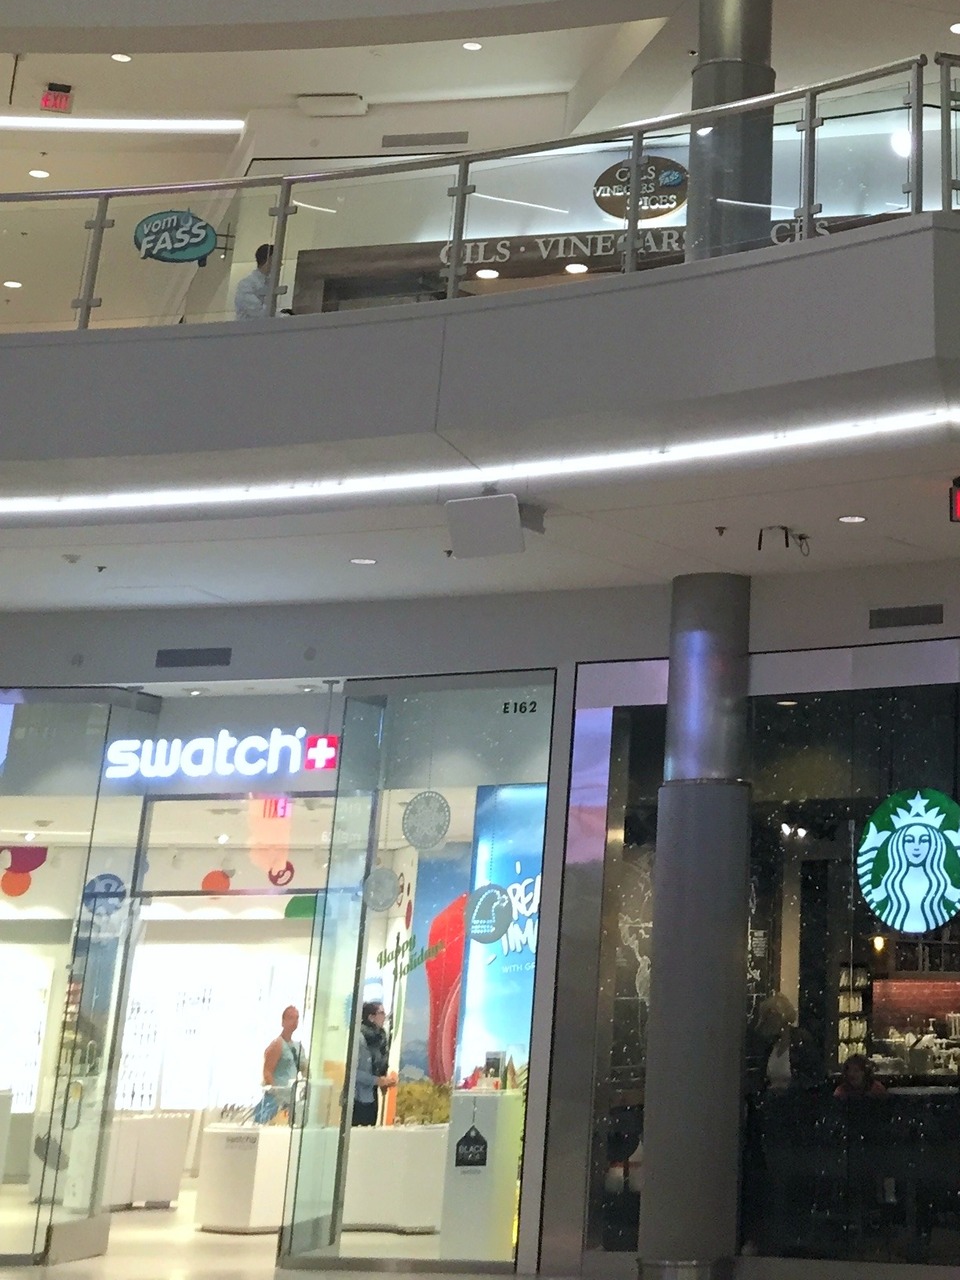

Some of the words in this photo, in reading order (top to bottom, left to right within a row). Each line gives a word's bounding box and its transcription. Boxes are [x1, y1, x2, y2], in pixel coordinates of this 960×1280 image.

[141, 221, 207, 259] FASS
[143, 215, 178, 235] vom
[105, 726, 306, 779] swatch
